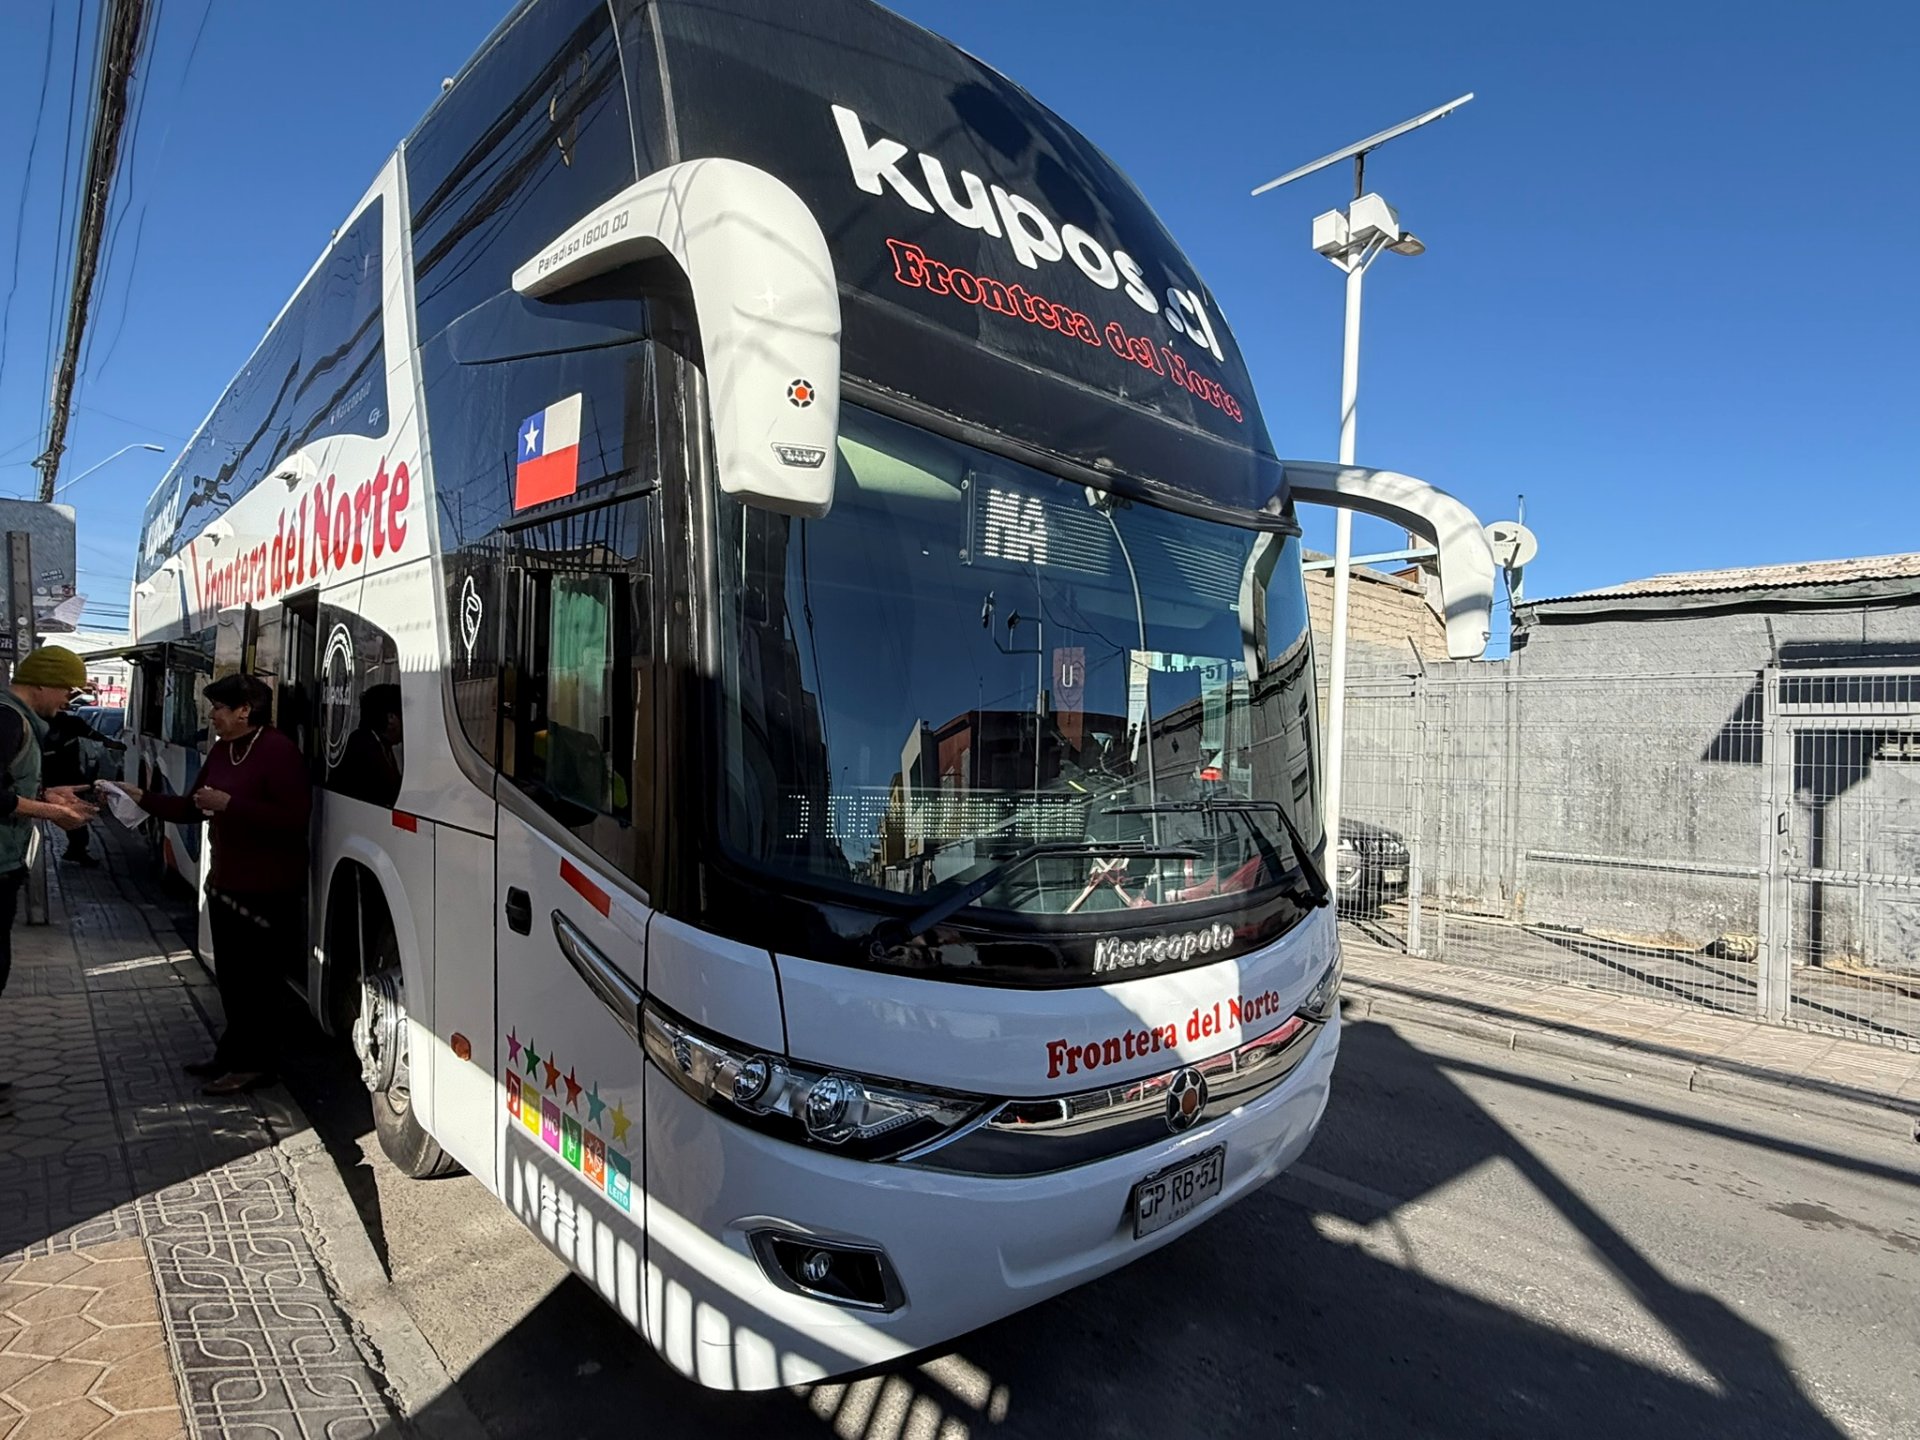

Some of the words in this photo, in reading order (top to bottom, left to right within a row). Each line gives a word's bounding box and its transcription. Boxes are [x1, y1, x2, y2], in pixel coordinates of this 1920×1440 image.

[831, 103, 1225, 362] kupos.cl
[886, 238, 1101, 347] Frontera
[1105, 321, 1165, 376] del
[1161, 346, 1244, 423] Norte
[203, 541, 267, 621] Frontera
[270, 492, 308, 597] del
[309, 455, 410, 579] Norte
[1093, 921, 1235, 972] Marcopolo
[1046, 1022, 1177, 1079] Frontera
[1186, 1001, 1222, 1043] del
[1227, 989, 1280, 1026] Norte
[608, 1183, 629, 1208] LEITO
